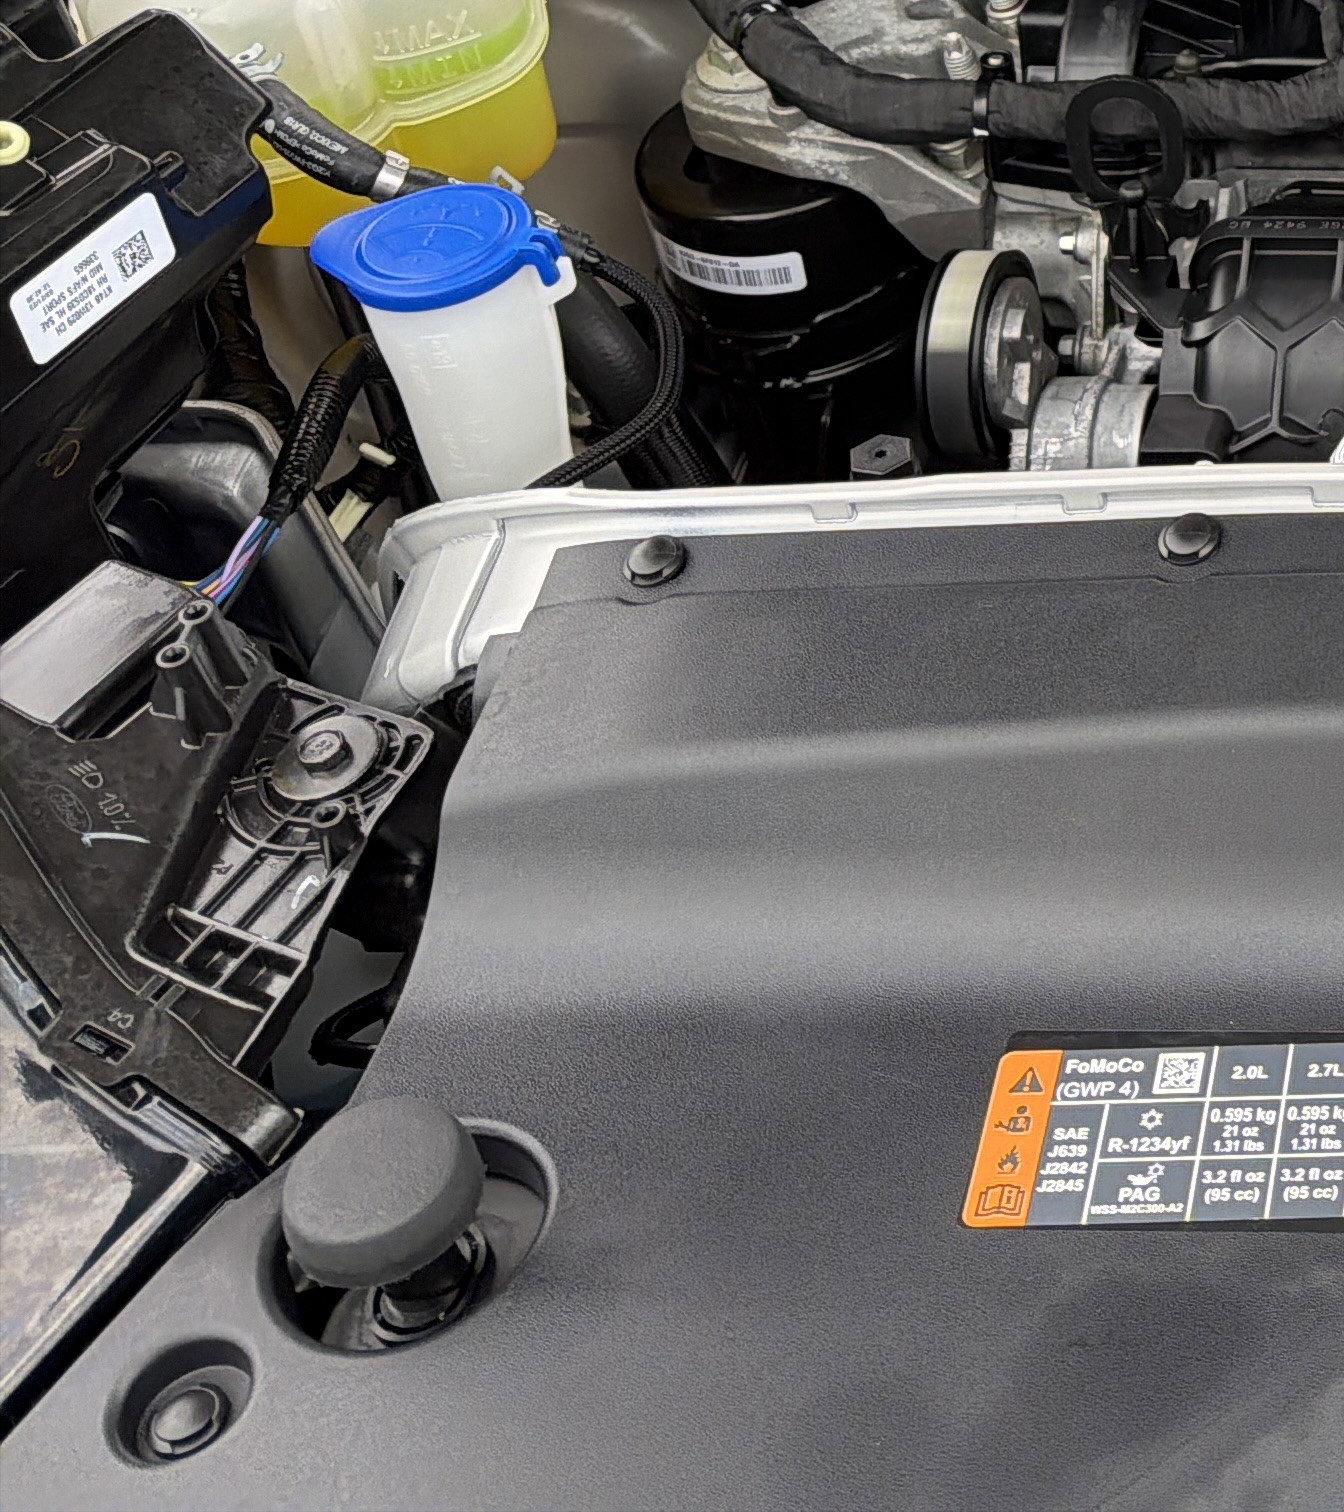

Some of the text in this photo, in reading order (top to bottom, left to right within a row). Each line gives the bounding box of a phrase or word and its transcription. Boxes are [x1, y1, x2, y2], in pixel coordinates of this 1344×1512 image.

[88, 262, 104, 279] MID
[96, 274, 109, 288] RH
[42, 291, 68, 316] SPORT
[39, 316, 55, 333] SAE
[1065, 1058, 1145, 1074] FoMoCo
[1231, 1065, 1269, 1080] 2.0L
[1307, 1063, 1344, 1078] 2.7L
[1056, 1079, 1140, 1101] (GWP 4)
[1210, 1107, 1276, 1125] 0.595 kg
[1287, 1106, 1330, 1122] 0.595
[1053, 1127, 1090, 1141] SAE
[1222, 1125, 1259, 1138] 21 oz
[1299, 1123, 1336, 1136] 21 oz
[1047, 1144, 1087, 1159] J639
[1107, 1136, 1192, 1155] R-1234yf
[1213, 1139, 1265, 1153] 1.31 lbs
[1290, 1137, 1342, 1151] 1.31 lbs
[1040, 1161, 1088, 1176] J2842
[1280, 1167, 1344, 1182] 3.2 fl oz
[1202, 1170, 1266, 1184] 3.2 fl oz
[1036, 1178, 1085, 1193] J2845
[1118, 1187, 1161, 1202] PAG
[1204, 1187, 1260, 1205] (95 cc)
[1283, 1185, 1339, 1203] (95 cc)
